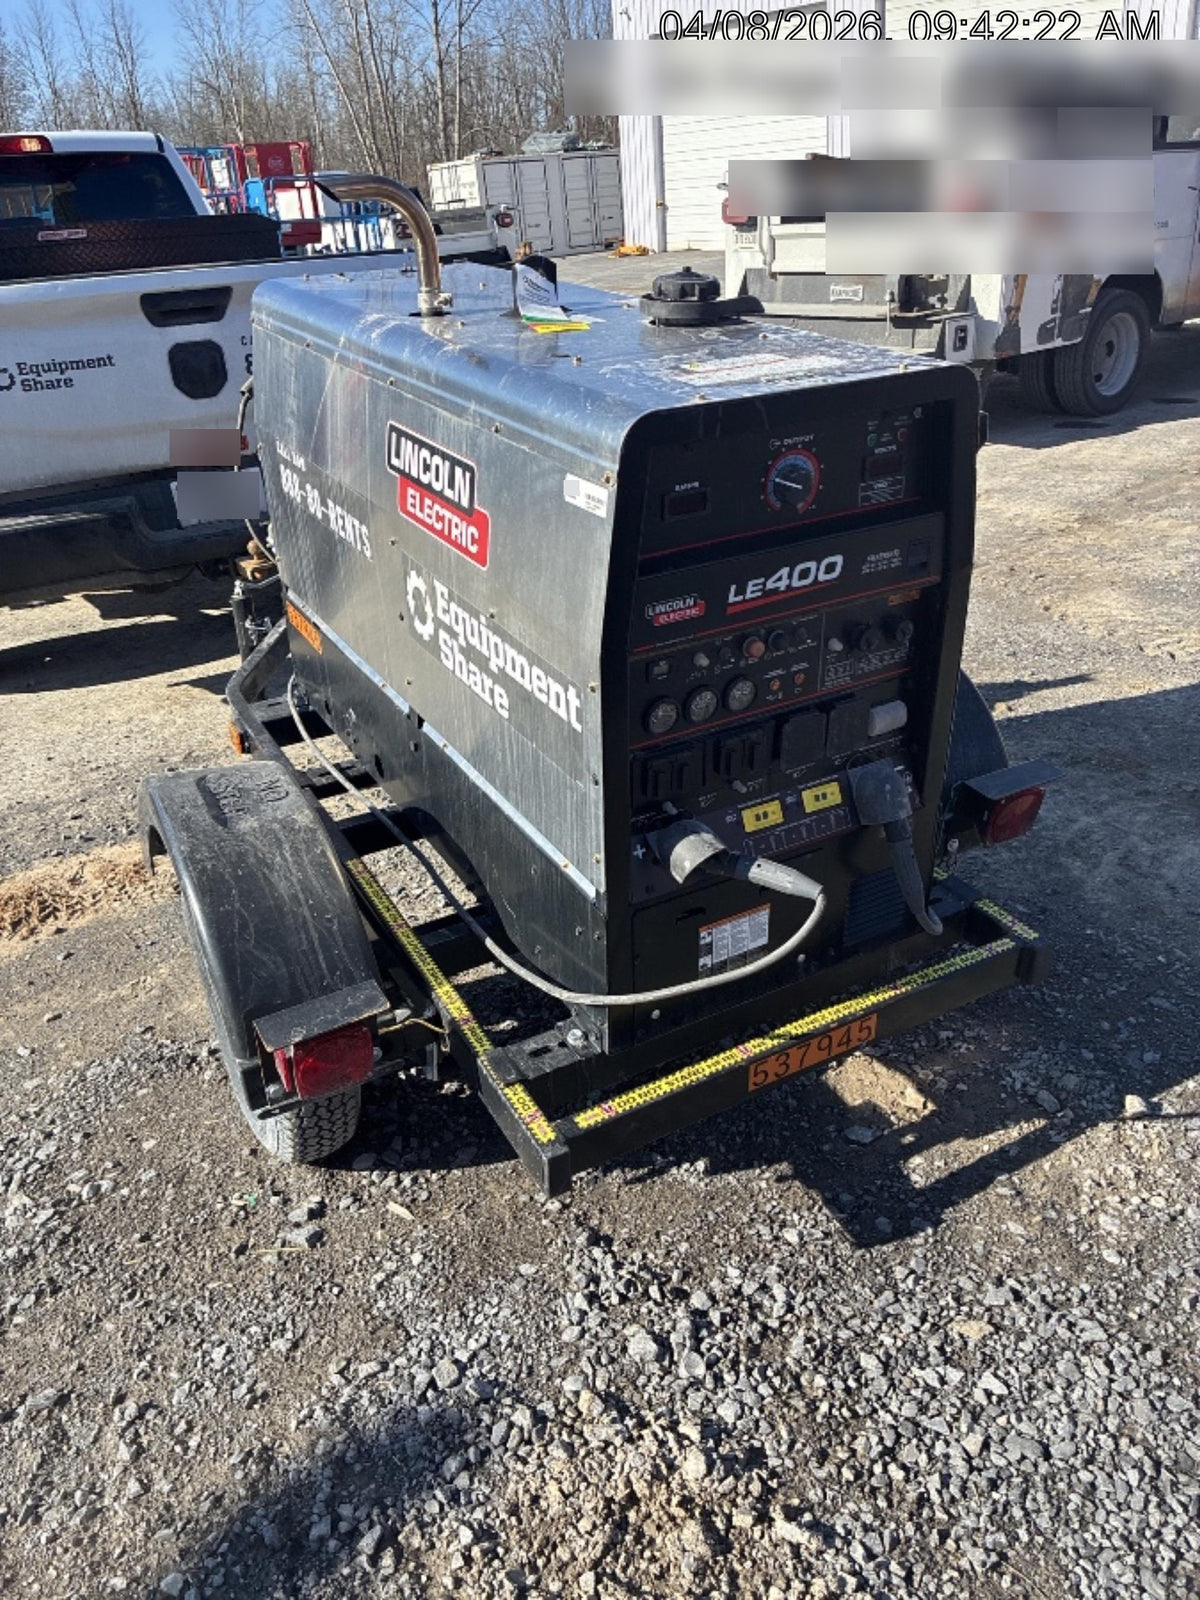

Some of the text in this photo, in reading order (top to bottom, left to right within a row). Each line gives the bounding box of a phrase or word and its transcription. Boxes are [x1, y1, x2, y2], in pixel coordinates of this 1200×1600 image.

[16, 353, 116, 377] Equipment
[20, 377, 75, 392] Share
[390, 431, 472, 509] LINCOLN
[406, 486, 480, 554] ELECTRIC
[648, 596, 695, 616] LINCOLN
[728, 554, 844, 603] LE400
[433, 578, 584, 733] Equipment
[438, 633, 510, 719] Share
[752, 1015, 874, 1088] 537945
[616, 1096, 637, 1108] DO
[638, 1083, 663, 1100] NOT
[664, 1065, 706, 1087] STAND
